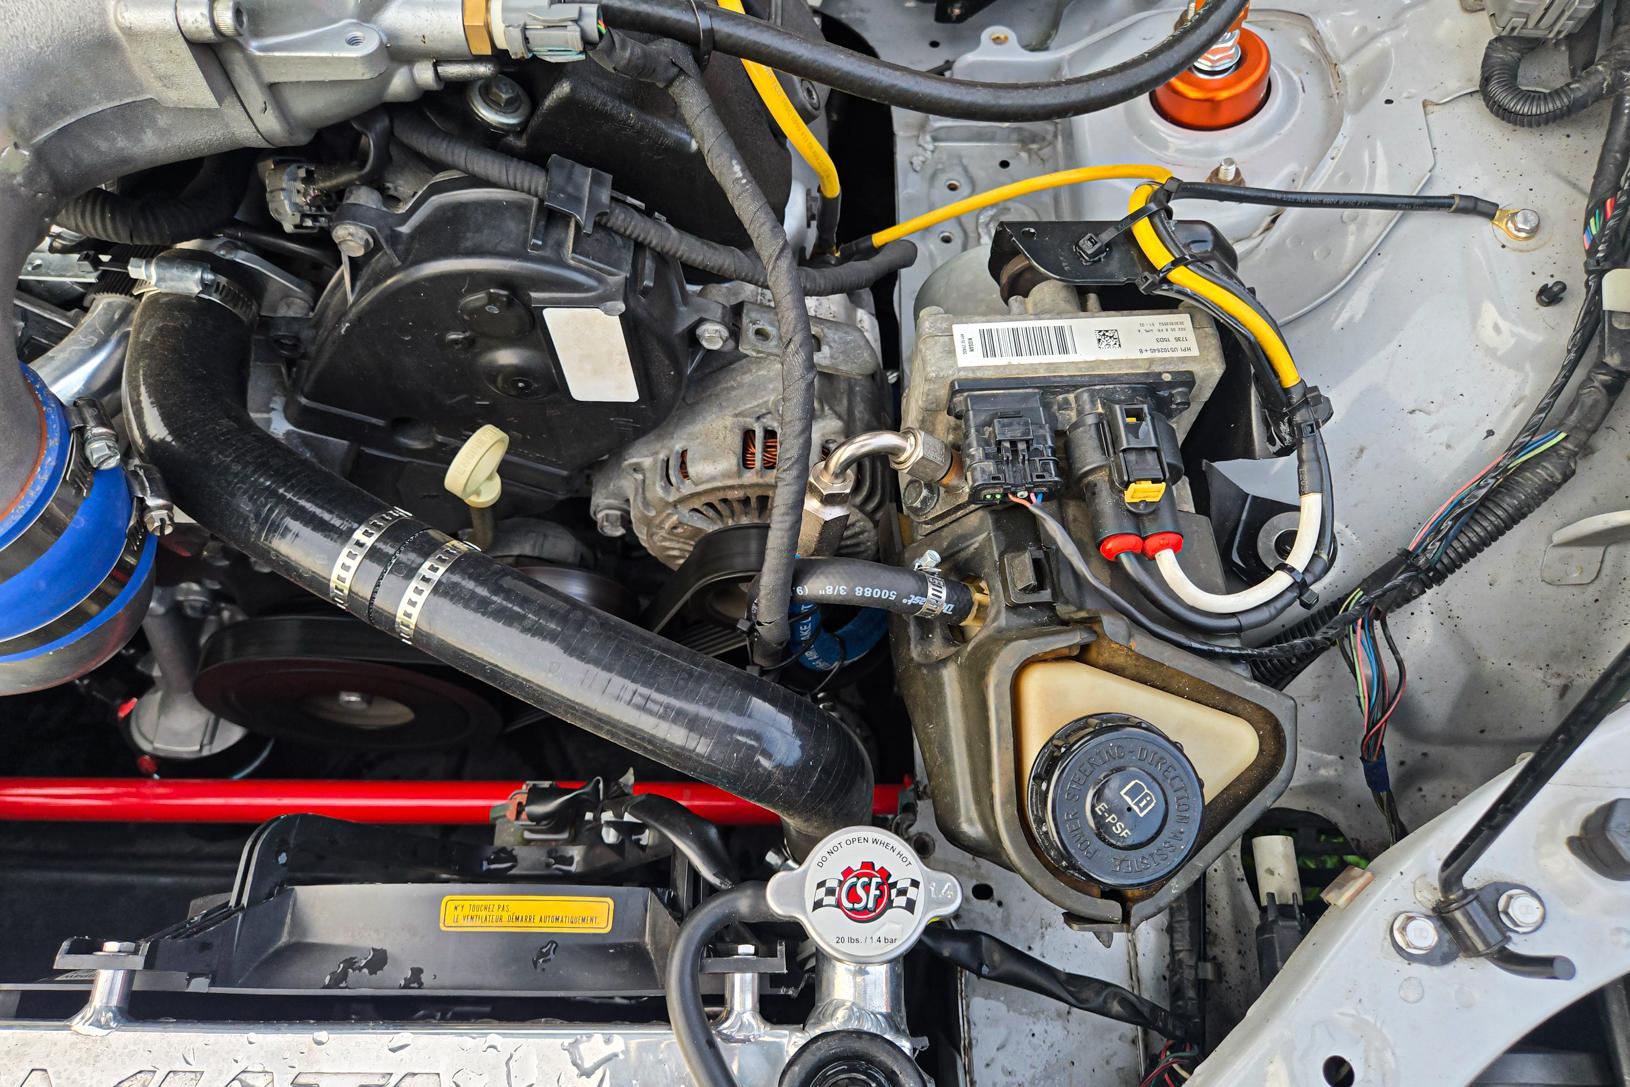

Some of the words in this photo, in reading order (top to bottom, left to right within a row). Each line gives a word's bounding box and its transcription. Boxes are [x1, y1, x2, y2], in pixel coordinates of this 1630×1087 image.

[855, 587, 898, 600] 50088
[1065, 744, 1126, 802] STEERING
[1137, 746, 1191, 825] DIRECTION
[1095, 802, 1132, 839] E-PSF
[816, 855, 828, 869] DO
[827, 842, 843, 858] NOT
[845, 836, 869, 846] OPEN
[871, 838, 897, 854] WHEN
[896, 850, 913, 868] HOT
[841, 877, 882, 911] CSF
[453, 915, 459, 923] LE
[462, 914, 503, 923] VENTILATEUR
[507, 912, 536, 923] DÉMARRE
[468, 904, 496, 913] TOUCHEZ
[836, 936, 846, 944] 20
[847, 936, 863, 944] lbs.
[884, 936, 898, 944] bar
